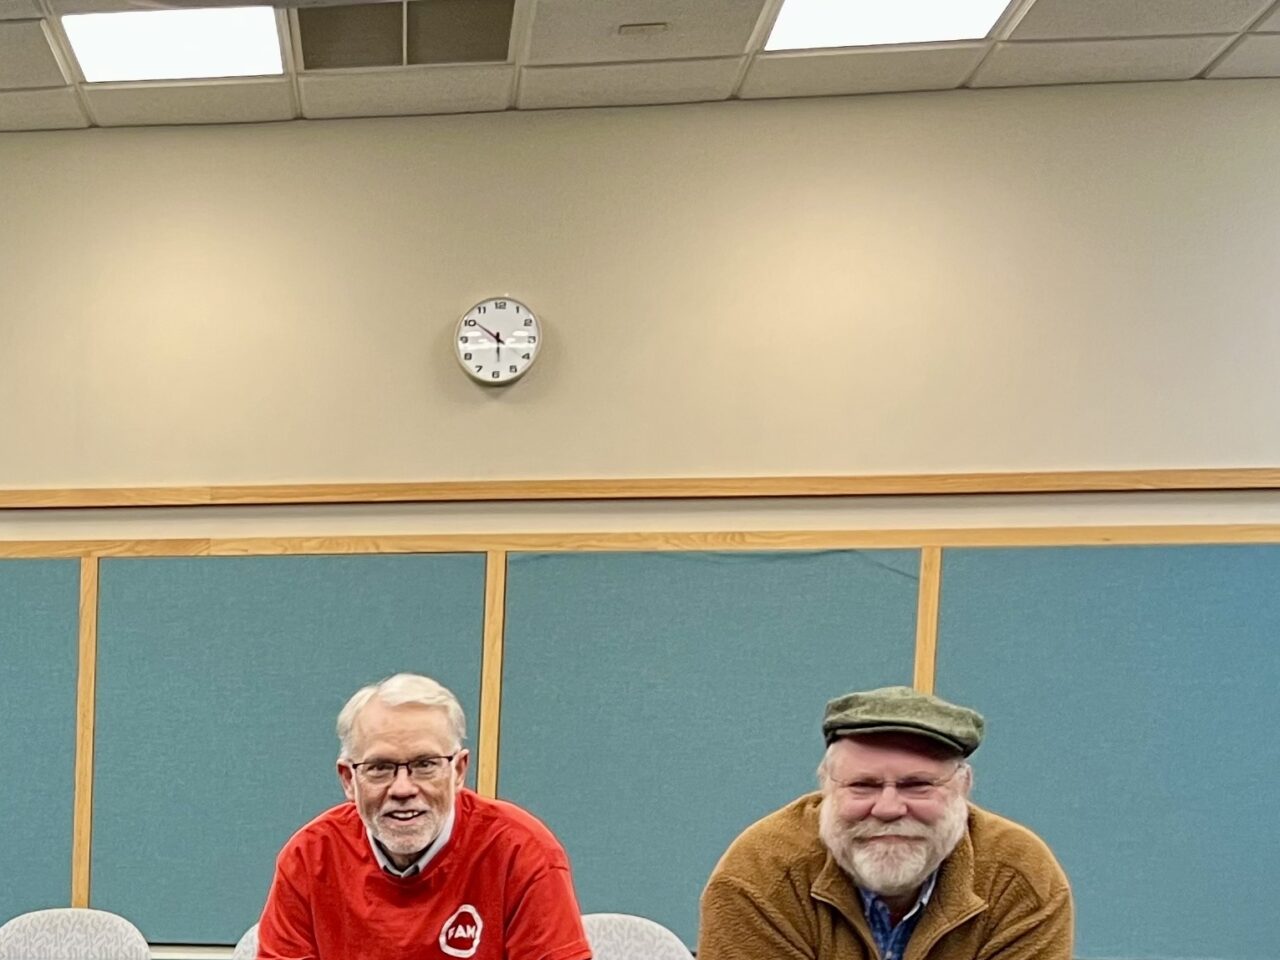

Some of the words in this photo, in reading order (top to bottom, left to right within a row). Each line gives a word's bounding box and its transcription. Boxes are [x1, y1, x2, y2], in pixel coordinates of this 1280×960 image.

[495, 301, 507, 310] 12
[477, 306, 486, 314] 11
[464, 319, 477, 327] 10
[524, 319, 533, 327] 2
[460, 336, 468, 344] 9
[464, 352, 472, 360] 8
[475, 365, 483, 373] 7
[509, 365, 517, 373] 5
